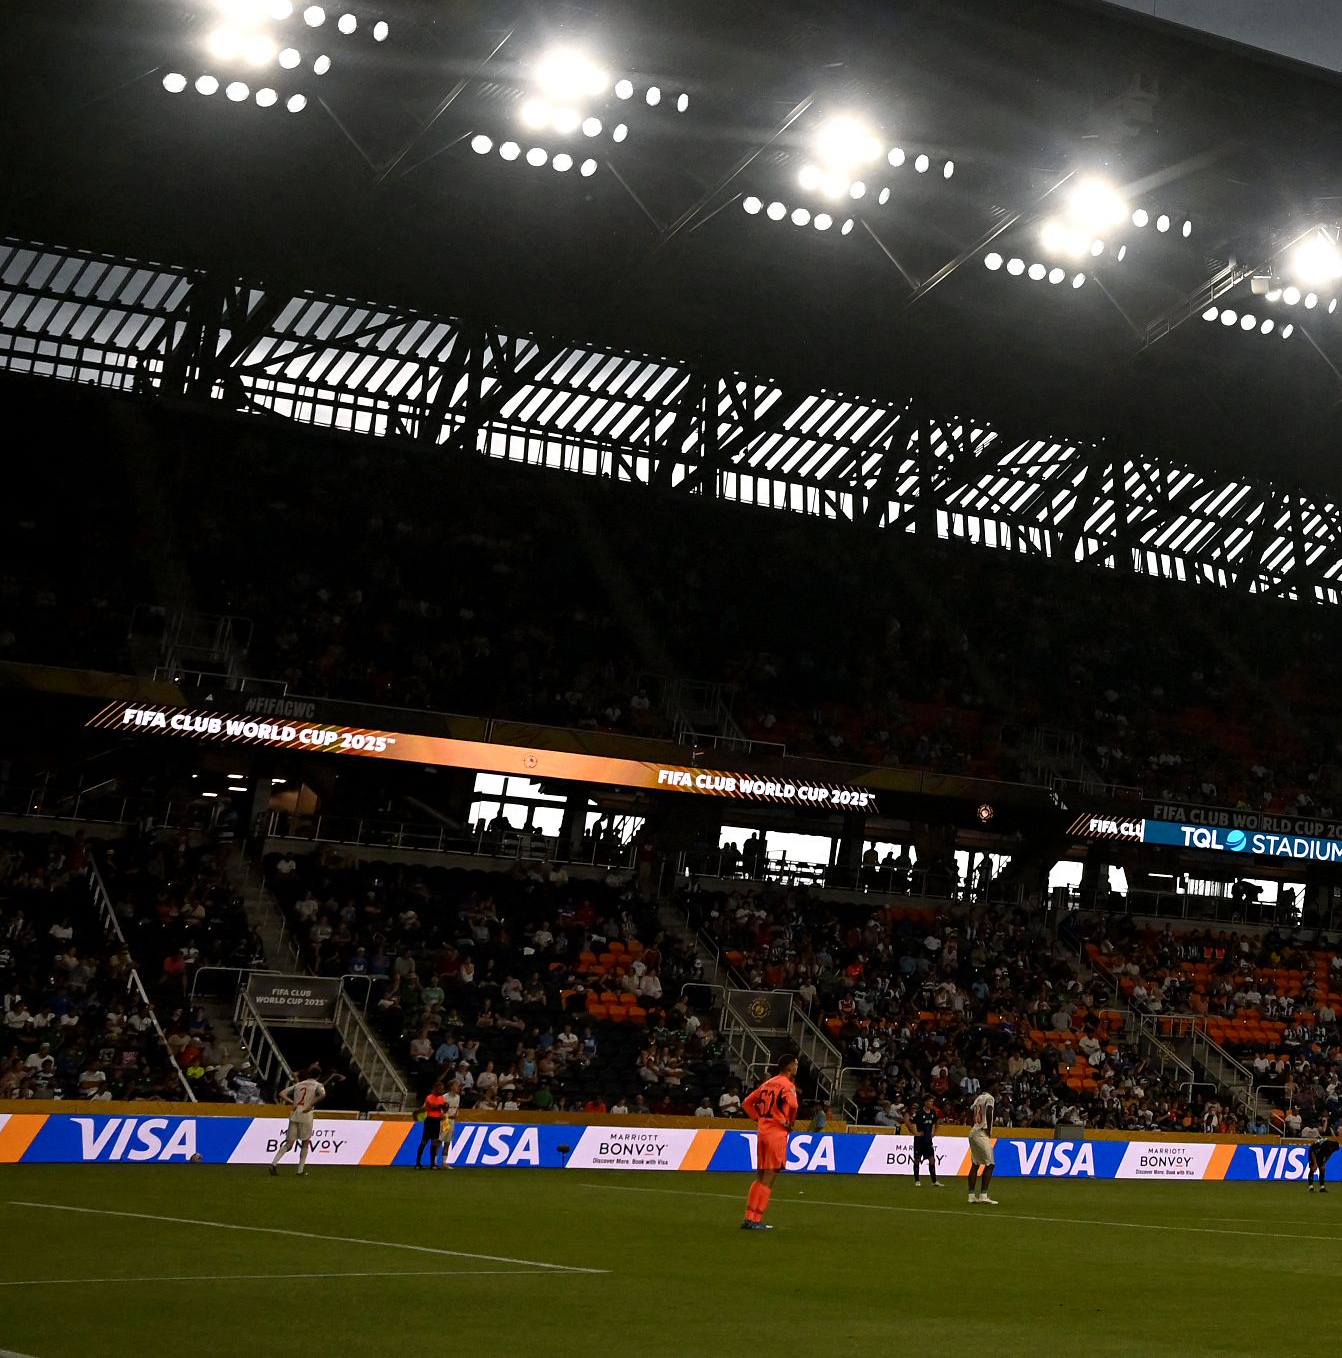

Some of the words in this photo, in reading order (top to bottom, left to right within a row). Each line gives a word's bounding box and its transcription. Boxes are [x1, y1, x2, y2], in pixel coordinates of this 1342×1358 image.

[244, 698, 316, 719] #FIFACWC
[123, 709, 166, 728] FIFA
[171, 714, 222, 734] CLUB
[226, 720, 296, 743] WORLD
[299, 729, 339, 747] CUP
[657, 769, 693, 787] FIFA
[696, 774, 736, 792] CLUB
[739, 779, 795, 798] WORLD
[798, 786, 829, 801] CUP
[1089, 818, 1118, 835] FIFA
[1153, 805, 1186, 820] FIFA
[1190, 809, 1229, 825] CLUB
[1232, 813, 1292, 832] WORLD
[1294, 821, 1324, 837] CUP
[1181, 826, 1224, 850] TQL
[255, 996, 285, 1004] WORLD
[286, 997, 304, 1006] CUP
[272, 988, 289, 996] FIFA
[290, 989, 312, 998] CLUB
[297, 1087, 307, 1106] 2
[758, 1089, 775, 1118] 52
[70, 1118, 197, 1160] VISA
[610, 1132, 658, 1141] MARRIOTT
[599, 1143, 666, 1156] BONVOY
[739, 1133, 836, 1171] VSA
[1009, 1141, 1096, 1176] VISA
[592, 1157, 614, 1165] Discover
[1140, 1156, 1191, 1168] BONVOY
